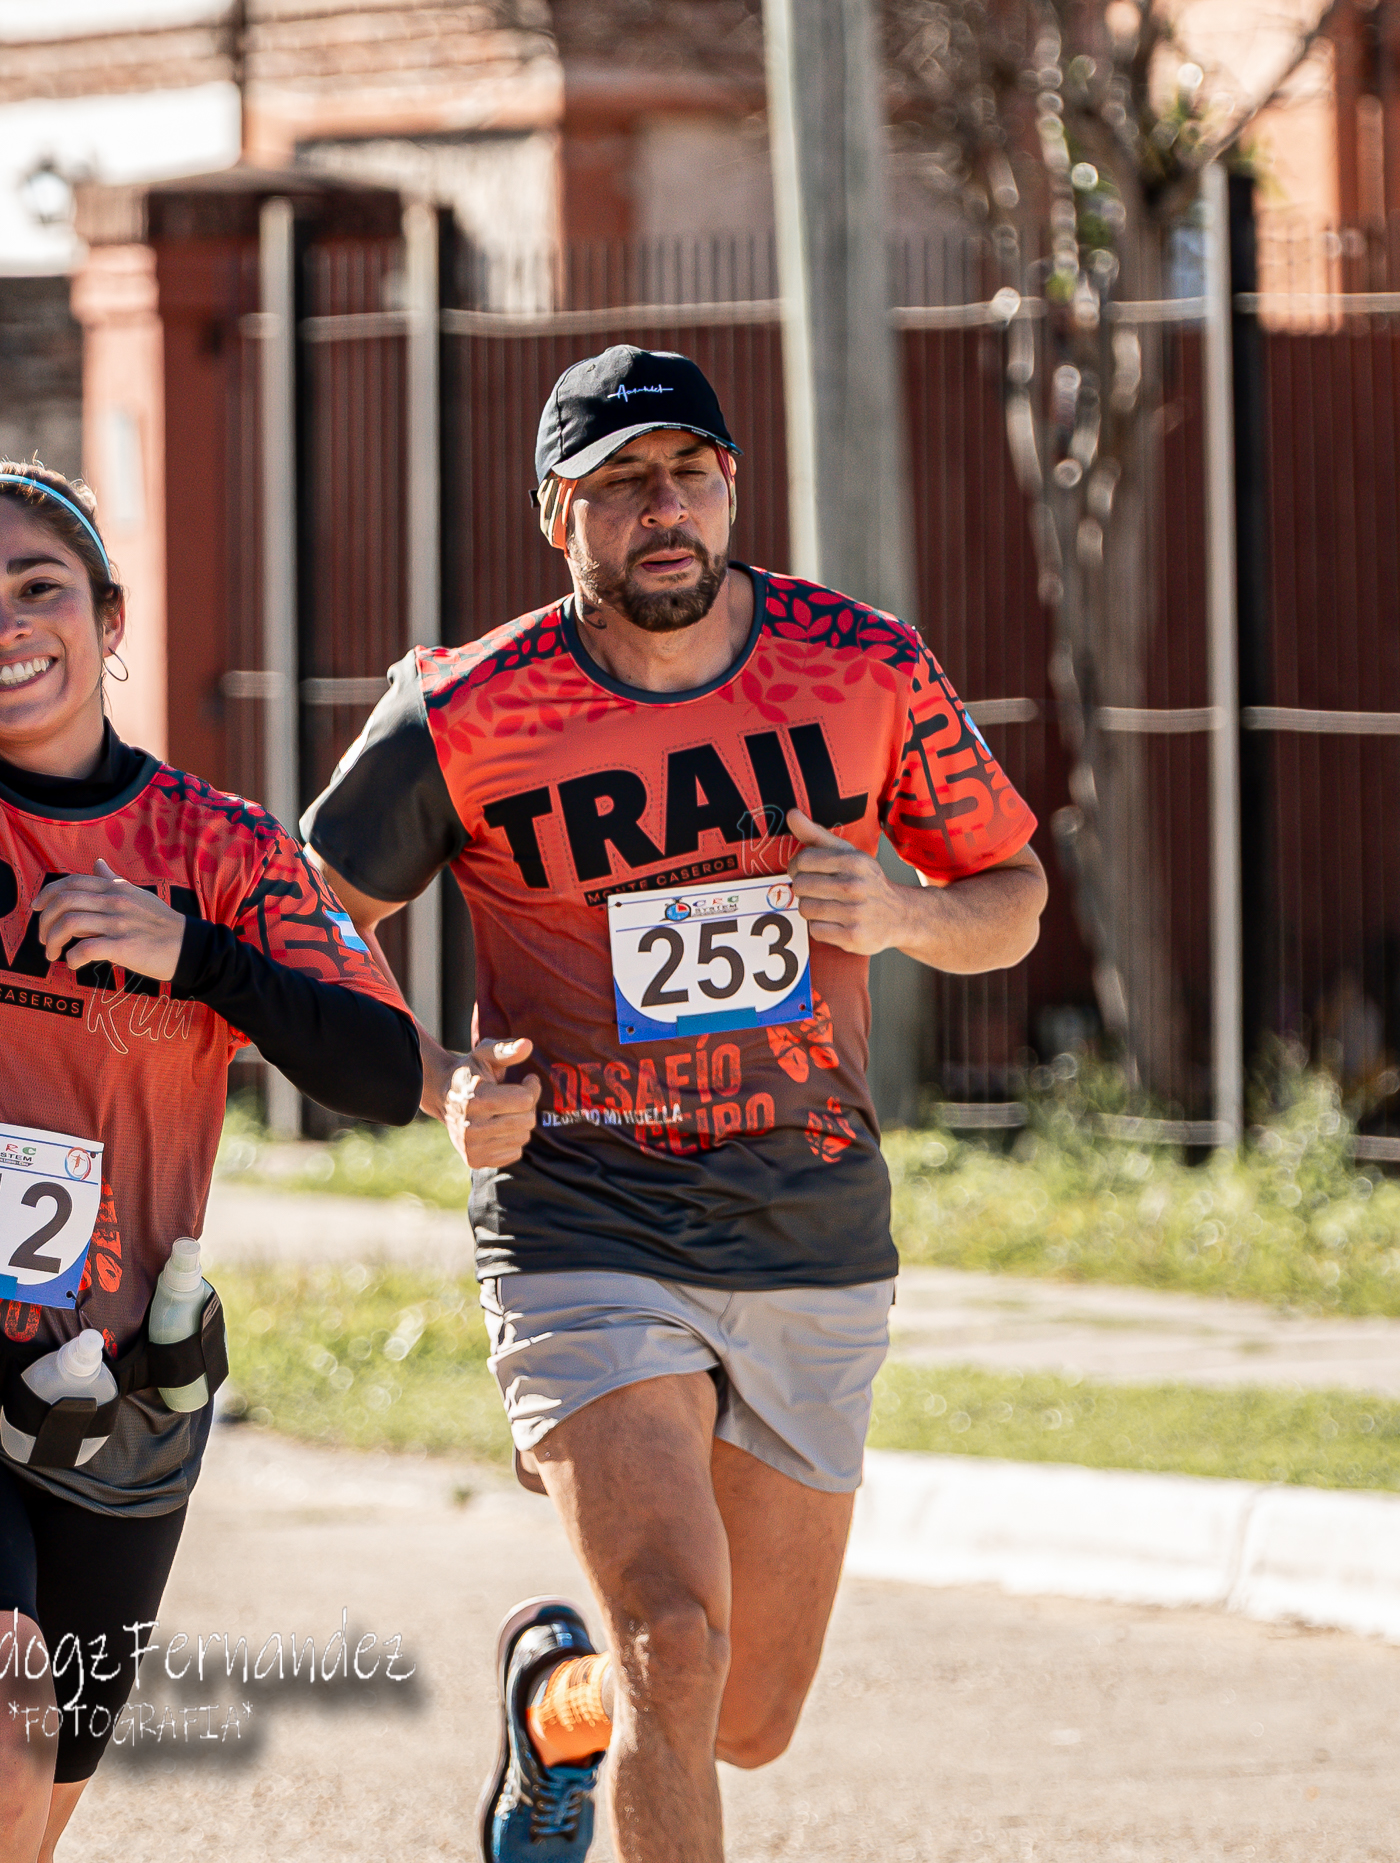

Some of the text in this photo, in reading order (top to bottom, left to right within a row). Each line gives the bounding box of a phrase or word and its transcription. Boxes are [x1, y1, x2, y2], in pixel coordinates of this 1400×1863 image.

[482, 721, 869, 888] TRAIL
[656, 857, 736, 886] CASEROS
[637, 912, 799, 1007] 253
[550, 1033, 741, 1113] DESAFÍO
